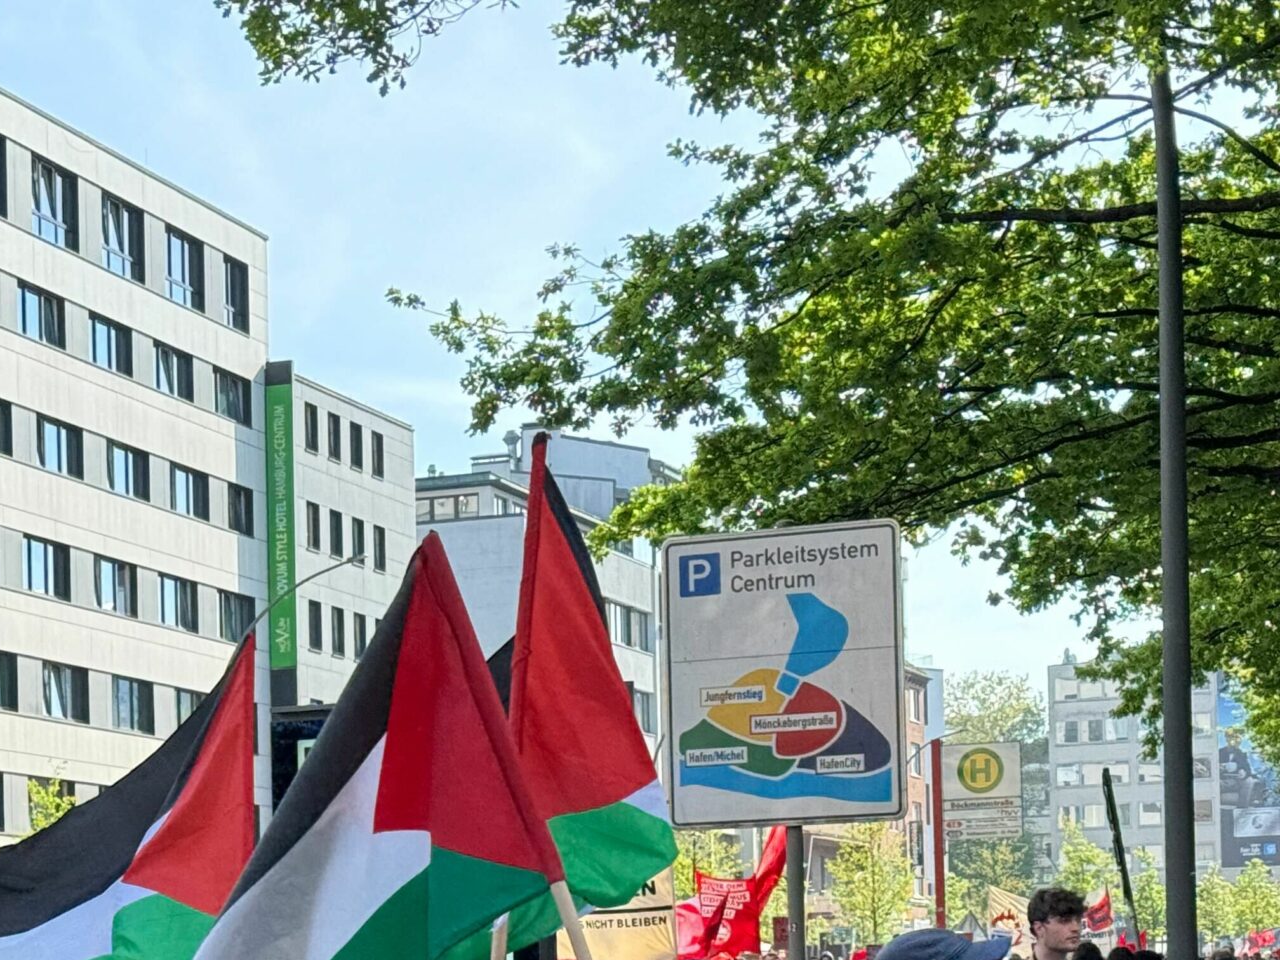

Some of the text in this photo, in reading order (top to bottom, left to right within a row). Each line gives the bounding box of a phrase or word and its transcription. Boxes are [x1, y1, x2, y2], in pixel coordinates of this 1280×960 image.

[273, 404, 286, 499] HAMBURG-CENTRUM
[275, 501, 286, 531] HOTEL
[276, 532, 287, 561] STYLE
[730, 542, 879, 569] Parkleitsystem
[688, 558, 711, 592] P
[730, 573, 816, 593] Centrum
[704, 689, 763, 704] Jungfernstieg
[753, 715, 835, 731] Mönckebergstraße
[688, 750, 745, 763] Hafen/Michel
[819, 756, 862, 770] HafenCity
[970, 762, 990, 783] H
[585, 919, 614, 929] NICHT
[616, 916, 668, 929] BLEIBEN
